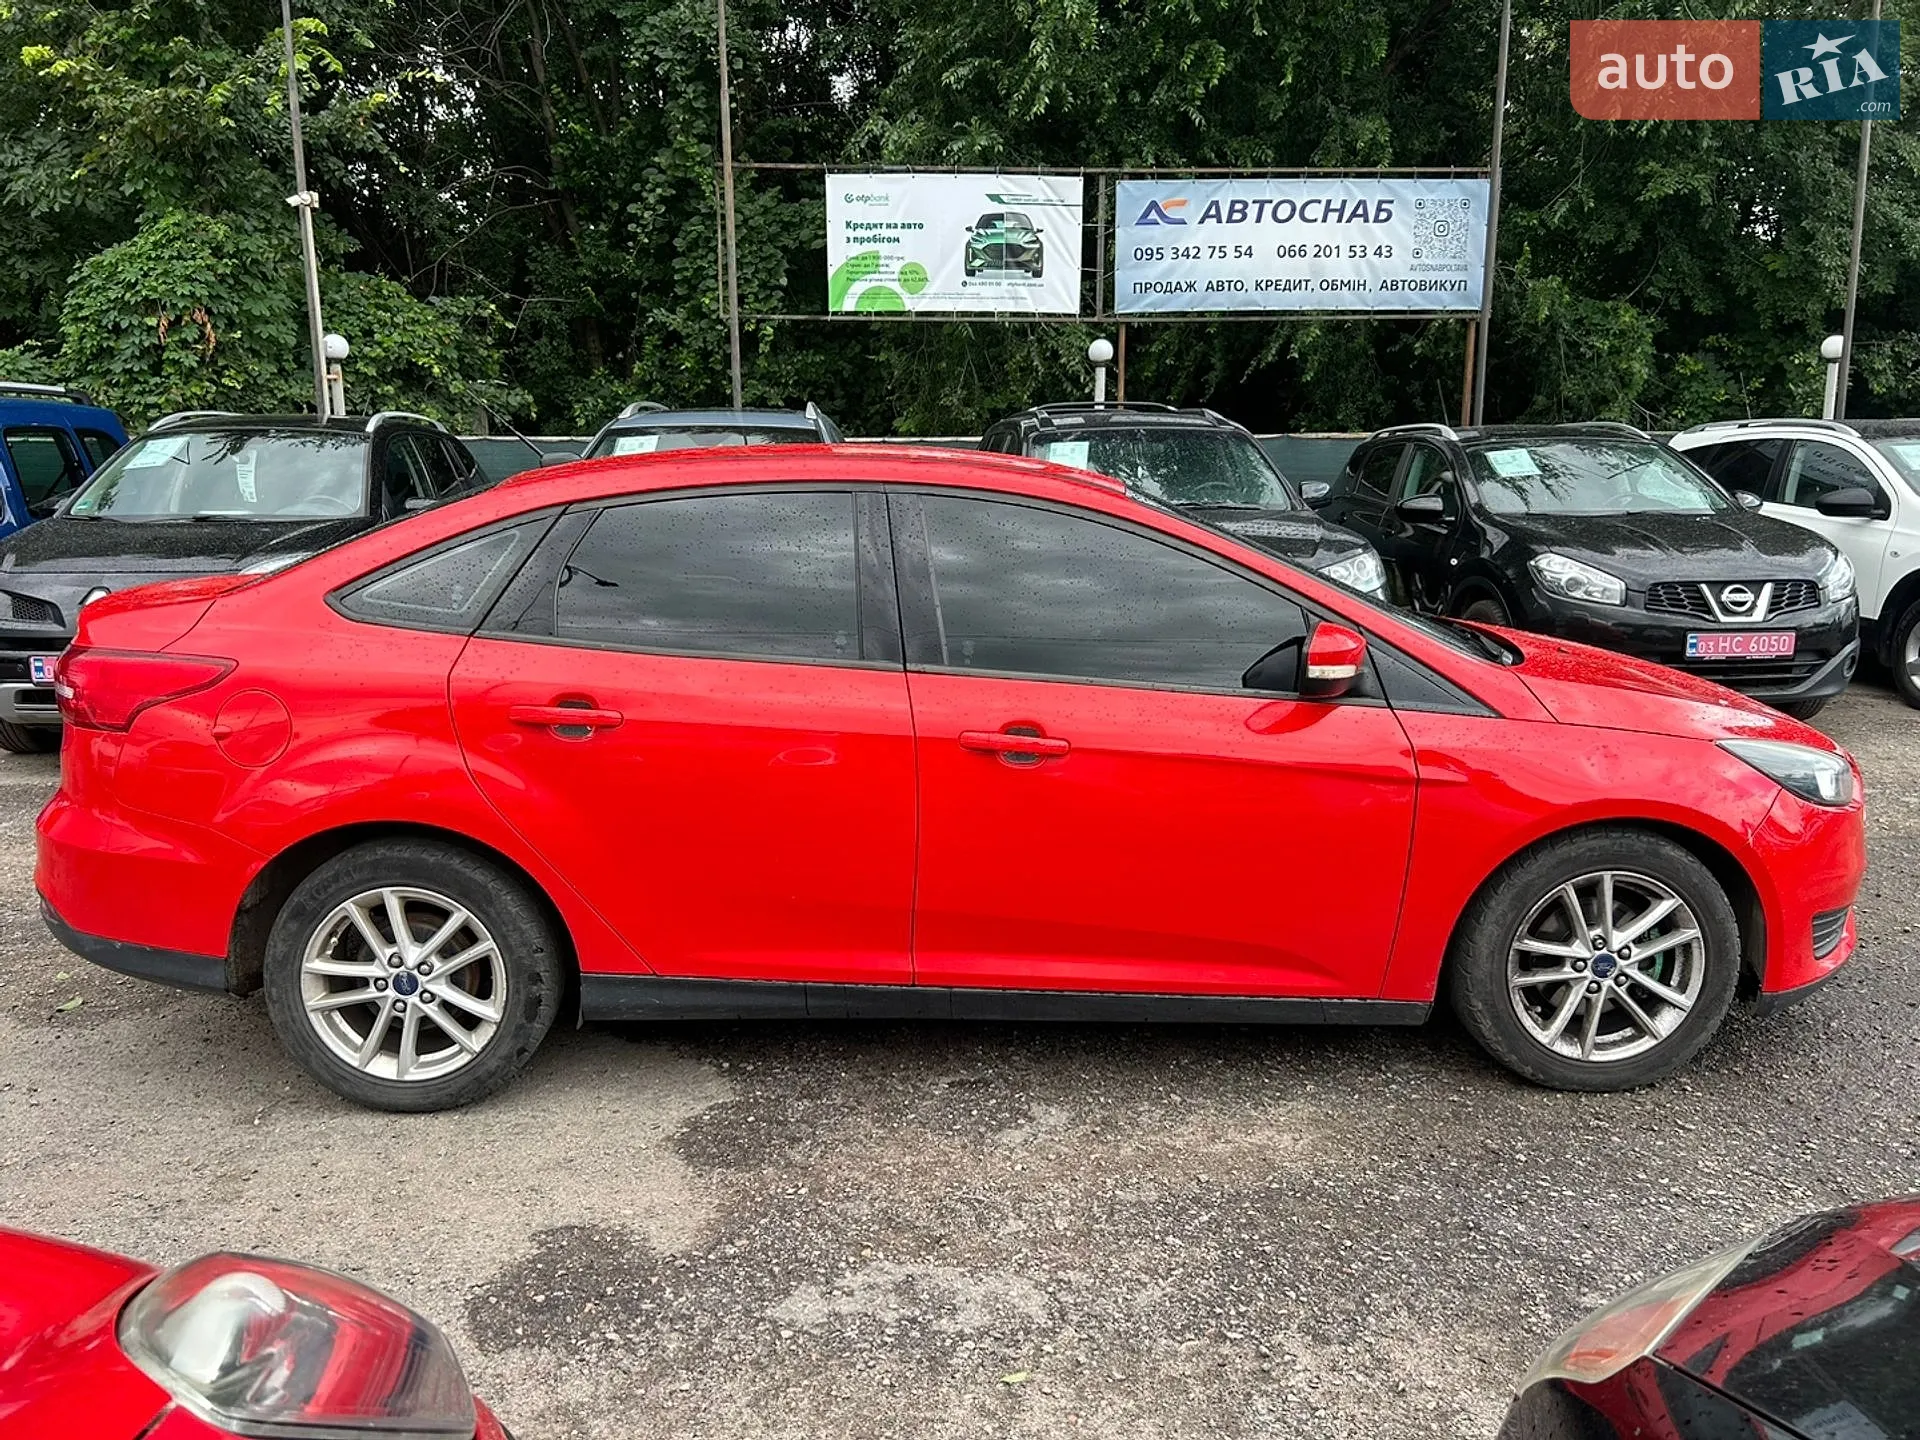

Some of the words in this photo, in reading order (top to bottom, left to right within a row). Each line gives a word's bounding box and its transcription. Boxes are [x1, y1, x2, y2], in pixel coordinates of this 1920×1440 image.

[855, 193, 889, 204] otpbank
[1197, 198, 1395, 225] АВТОСНАБ
[845, 220, 884, 231] Кредит
[885, 222, 899, 230] на
[900, 222, 924, 230] авто
[845, 236, 851, 244] з
[852, 233, 900, 245] пробігом
[1133, 246, 1164, 261] 095
[1171, 246, 1201, 260] 342
[1208, 245, 1228, 259] 75
[1234, 245, 1254, 259] 54
[1276, 244, 1307, 259] 066
[1313, 244, 1341, 259] 201
[1348, 244, 1368, 259] 53
[1373, 244, 1393, 259] 43
[1133, 281, 1197, 295] ПРОДАЖ
[1204, 280, 1249, 294] АВТО,
[1254, 279, 1316, 294] КРЕДИТ,
[1319, 278, 1372, 294] ОБМІН,
[1378, 278, 1468, 292] АВТОВИКУП
[1697, 642, 1714, 654] 03
[1749, 635, 1790, 652] 6050
